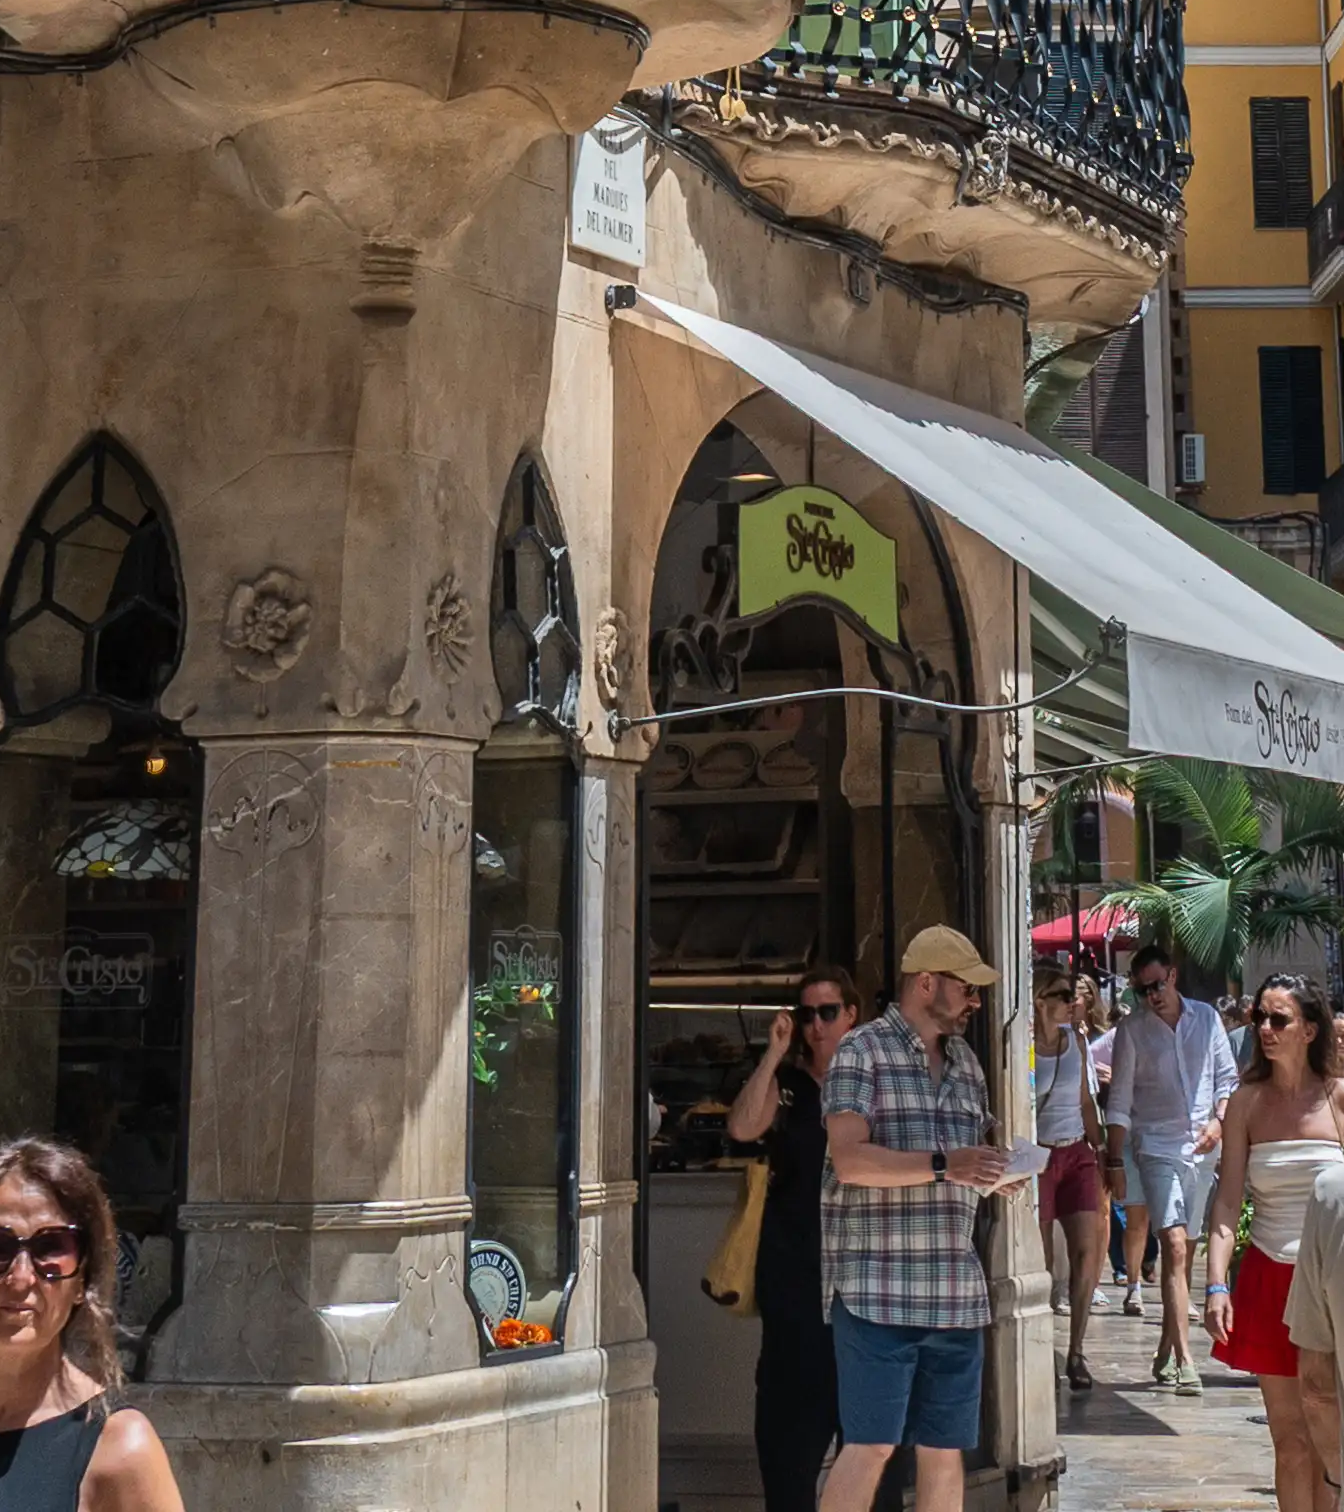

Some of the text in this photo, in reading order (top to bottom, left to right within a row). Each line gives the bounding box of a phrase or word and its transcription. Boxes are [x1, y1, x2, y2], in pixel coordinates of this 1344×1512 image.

[603, 215, 634, 245] PALMER
[58, 945, 143, 995] Cristo
[470, 1251, 501, 1270] ORNO
[508, 1278, 520, 1319] CRIST
